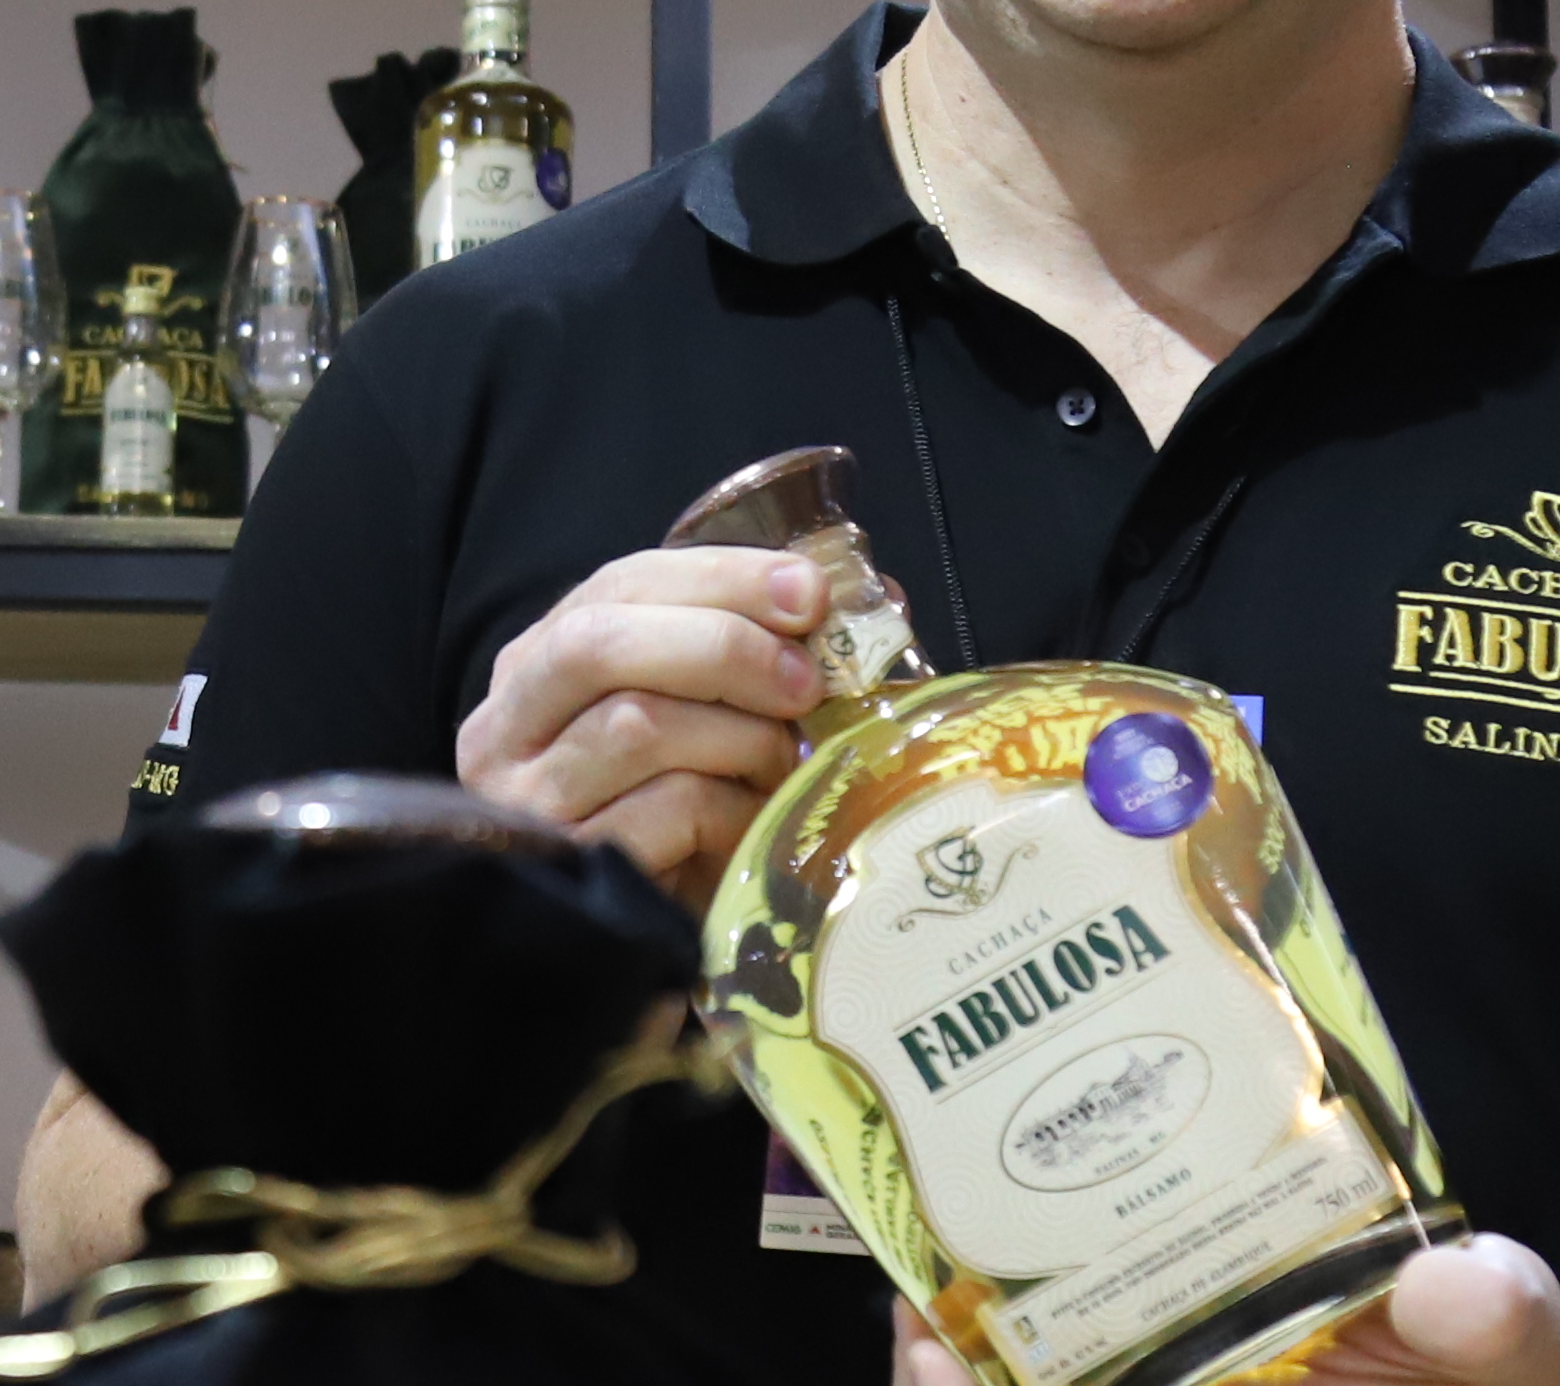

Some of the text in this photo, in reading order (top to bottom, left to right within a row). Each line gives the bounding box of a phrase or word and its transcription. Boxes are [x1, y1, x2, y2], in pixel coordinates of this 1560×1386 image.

[948, 907, 1053, 975] CACHAÇA
[897, 904, 1172, 1095] FABULOSA
[1313, 1167, 1381, 1221] 750 ml
